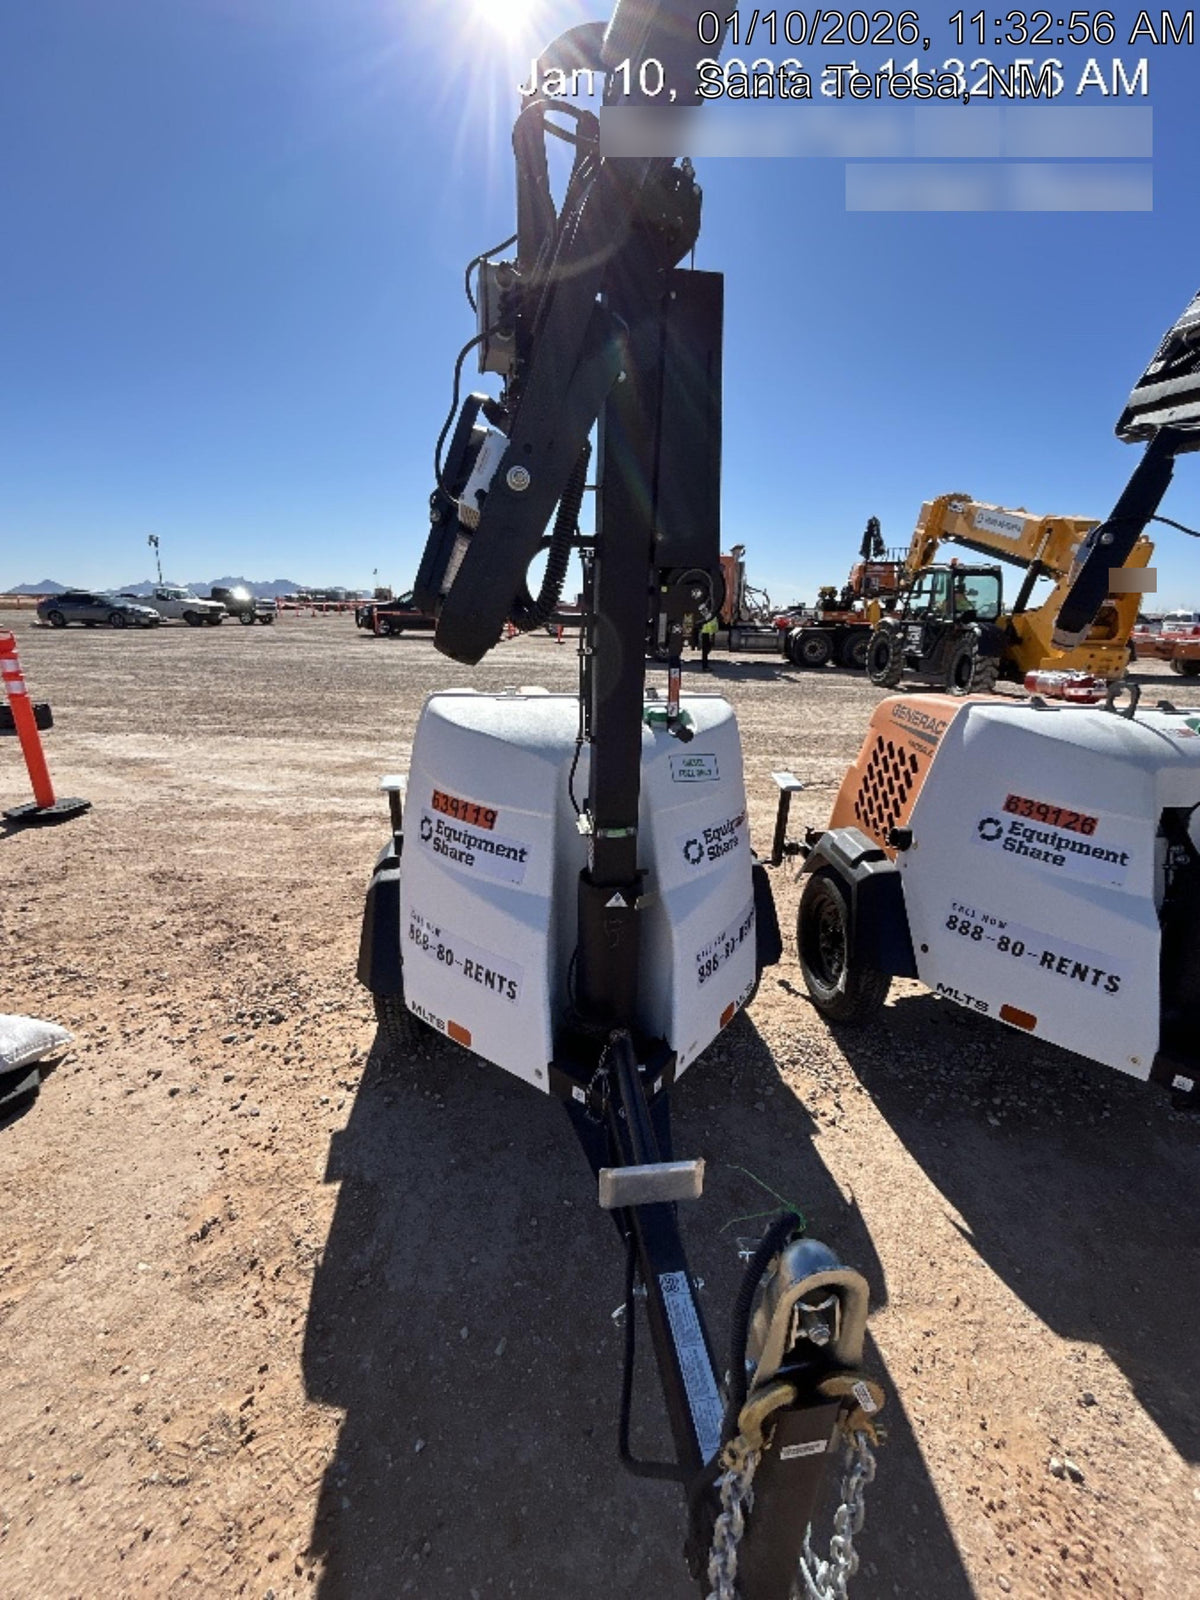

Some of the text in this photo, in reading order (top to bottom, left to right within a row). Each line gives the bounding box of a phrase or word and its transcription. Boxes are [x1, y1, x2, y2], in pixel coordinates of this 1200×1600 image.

[432, 790, 498, 830] 639119
[1004, 795, 1098, 836] 639126
[433, 837, 475, 867] Share
[435, 819, 528, 863] Equipment
[1002, 836, 1066, 867] Share
[1008, 820, 1130, 866] Equipment
[408, 923, 518, 1000] 888-80-RENTS
[945, 914, 1122, 993] 888-80-RENTS
